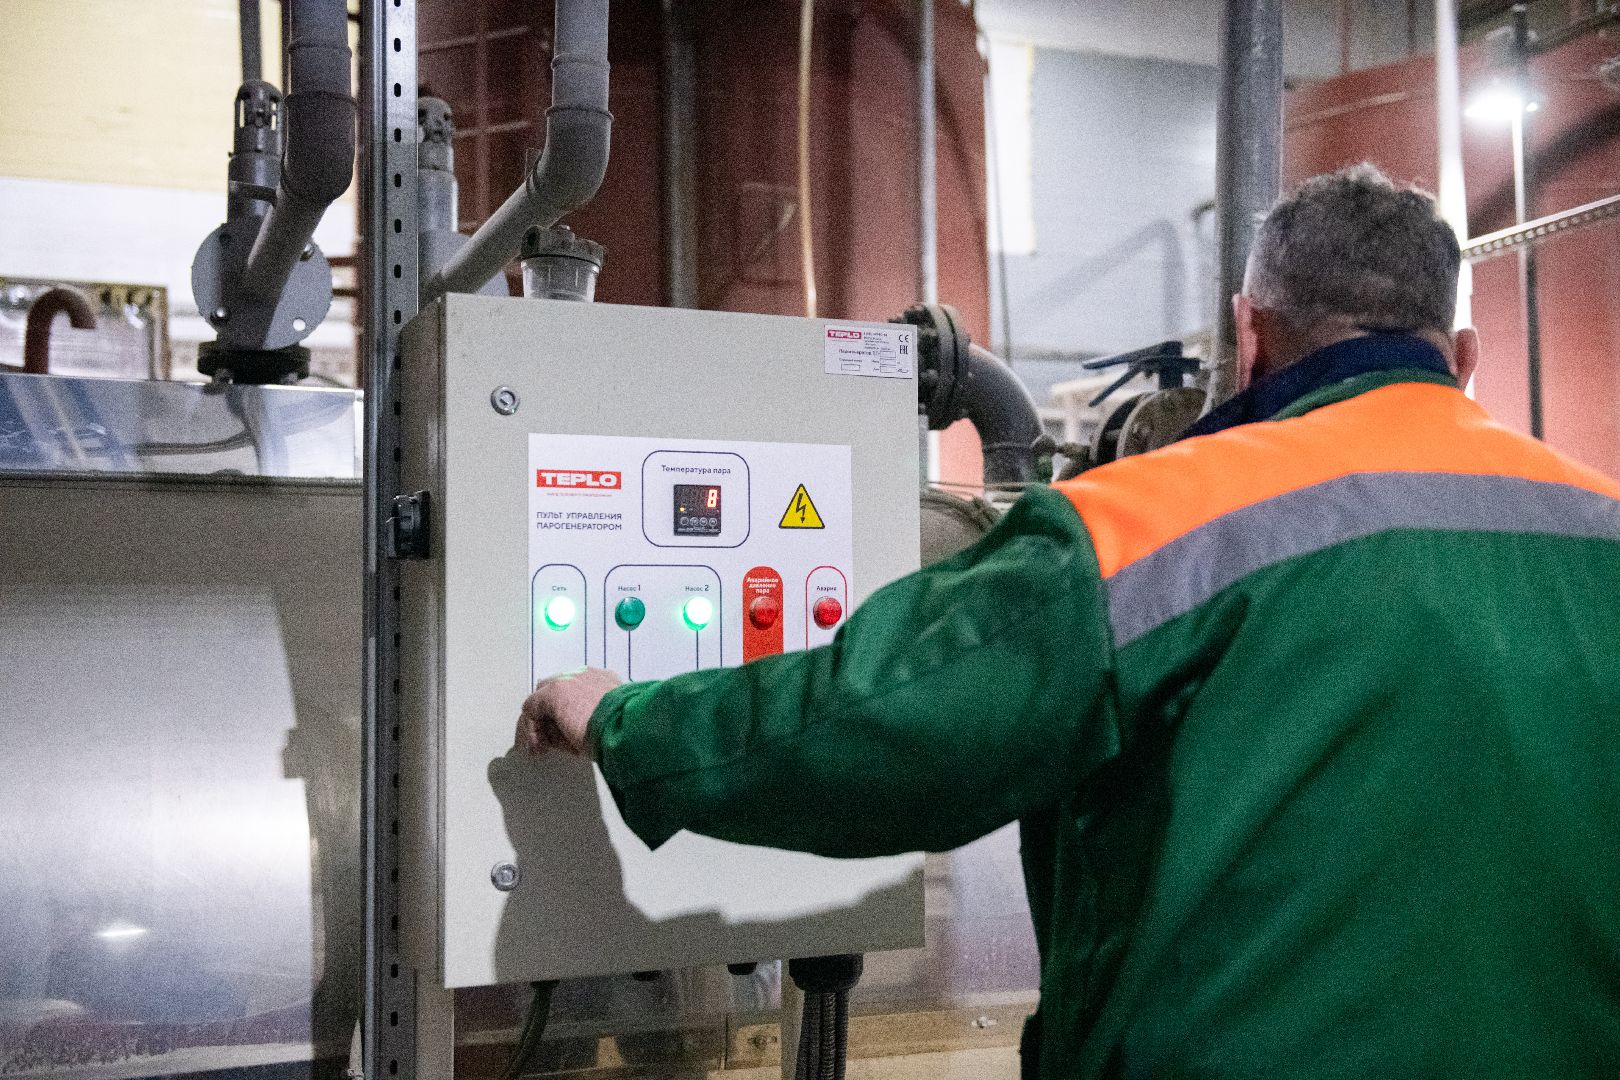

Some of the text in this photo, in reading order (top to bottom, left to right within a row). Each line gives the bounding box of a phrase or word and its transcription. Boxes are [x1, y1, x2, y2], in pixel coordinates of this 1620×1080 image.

[828, 331, 860, 339] TEPLO
[661, 465, 711, 475] Температура
[540, 472, 617, 487] TEPLO
[707, 489, 718, 507] 8
[536, 511, 622, 520] ПУЛЬТ УПРАВЛЕНИЯ
[536, 522, 622, 530] ПАРОГЕНЕРАТОРОМ
